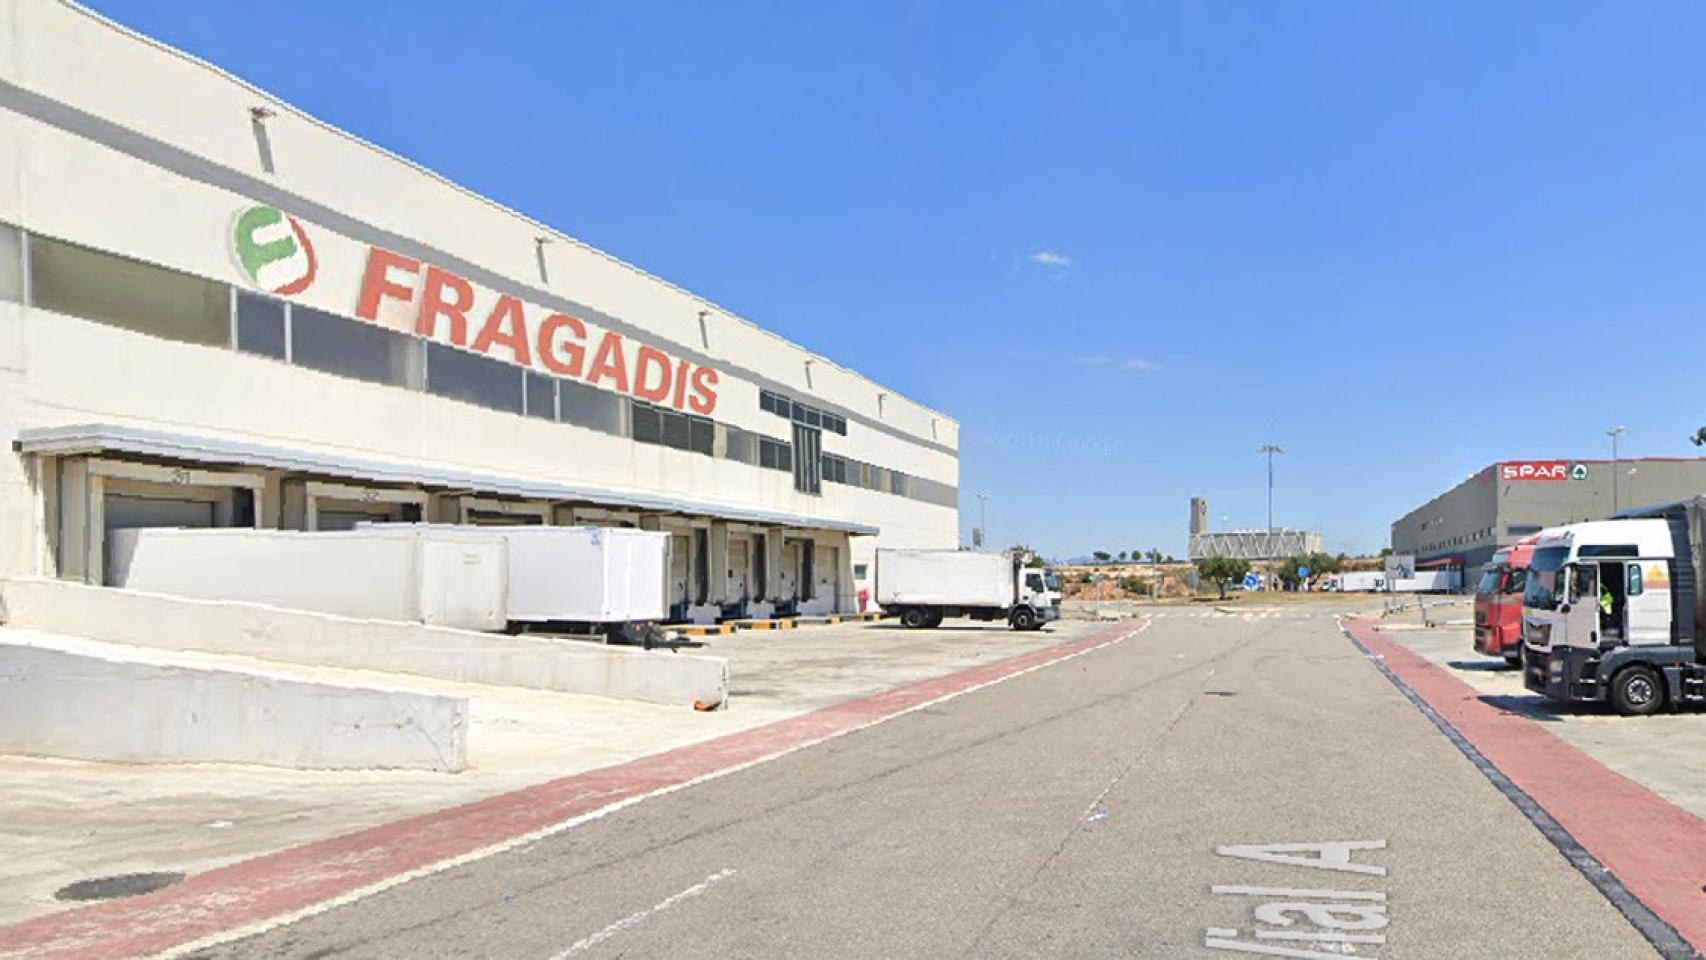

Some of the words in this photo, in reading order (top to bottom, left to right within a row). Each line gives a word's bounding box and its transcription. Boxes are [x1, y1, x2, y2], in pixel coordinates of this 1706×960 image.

[355, 246, 720, 416] FRAGADIS
[1503, 463, 1567, 480] SPAR
[1215, 839, 1387, 877] A
